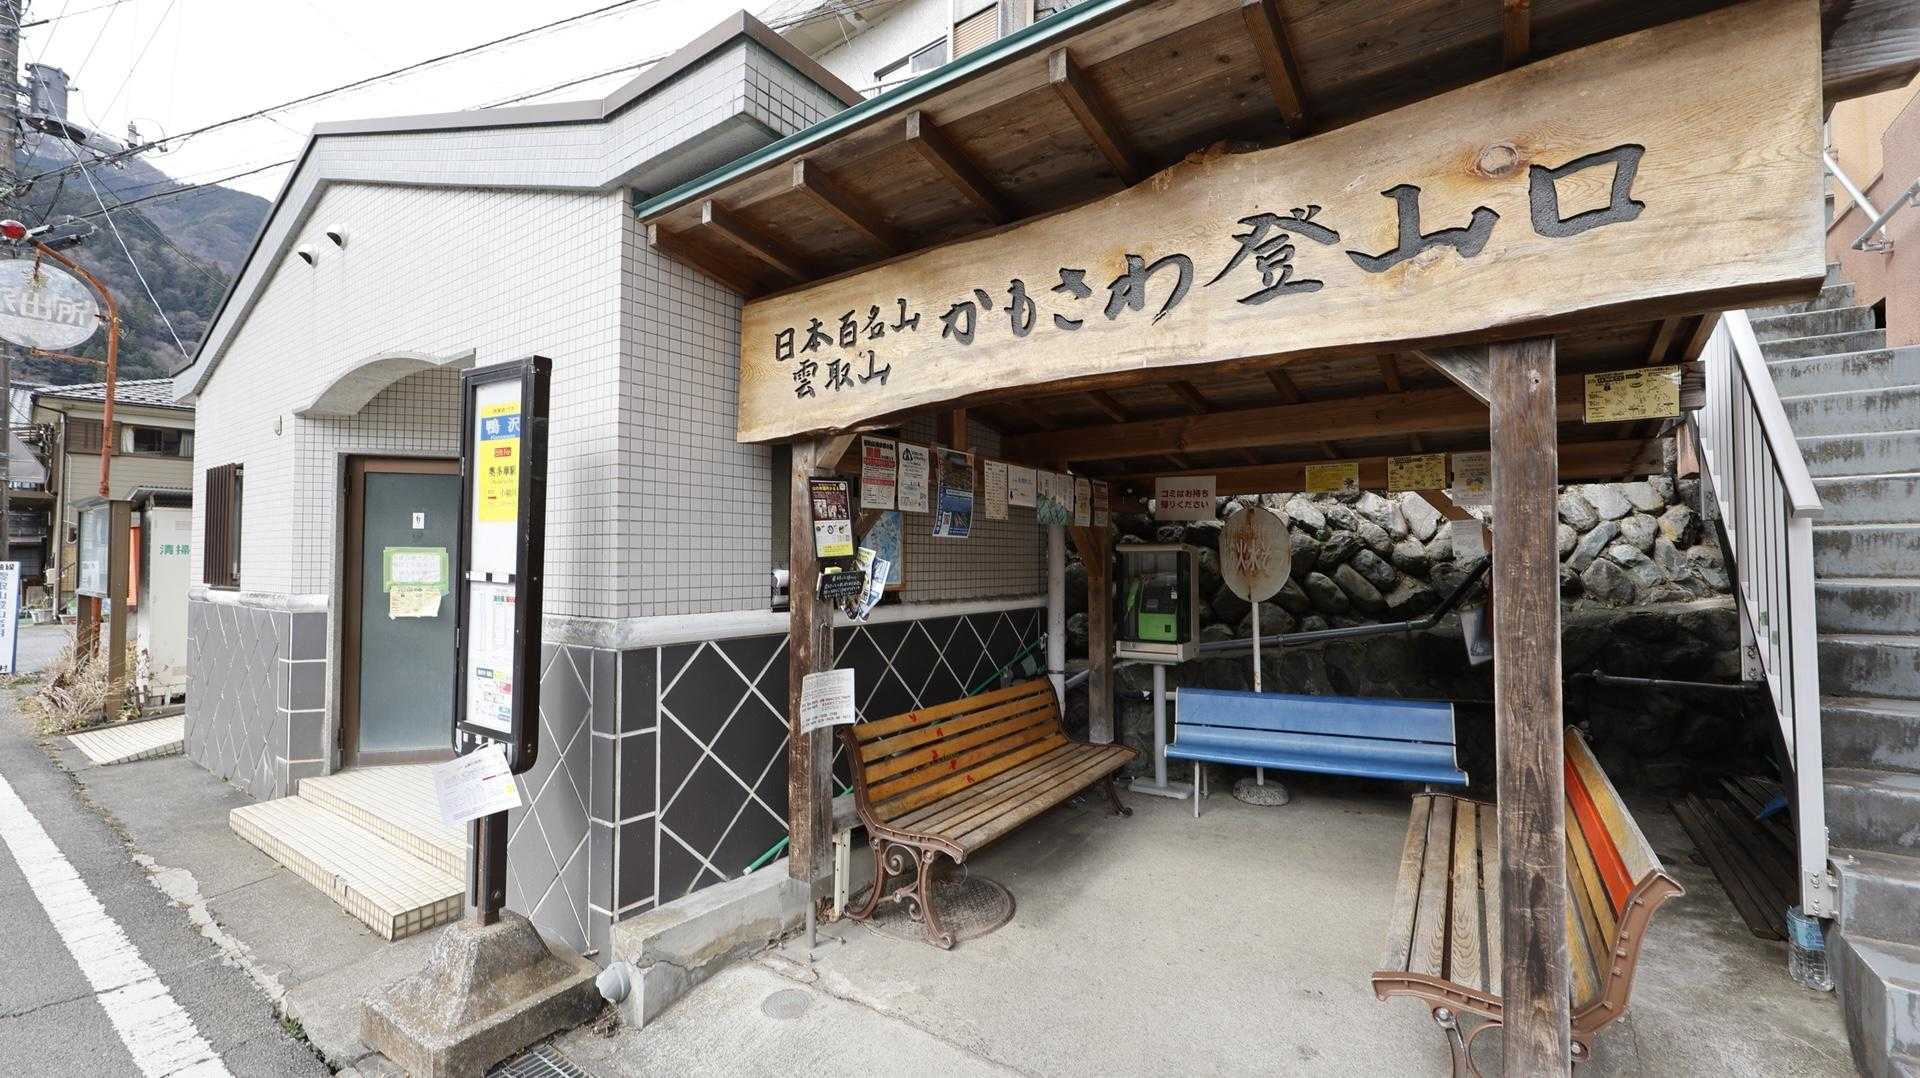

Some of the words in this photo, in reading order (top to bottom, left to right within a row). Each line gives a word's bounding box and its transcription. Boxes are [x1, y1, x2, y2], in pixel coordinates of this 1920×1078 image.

[939, 143, 1646, 346] かもさわ登山口
[775, 297, 921, 363] 日本百名山
[792, 349, 892, 400] 雲取山
